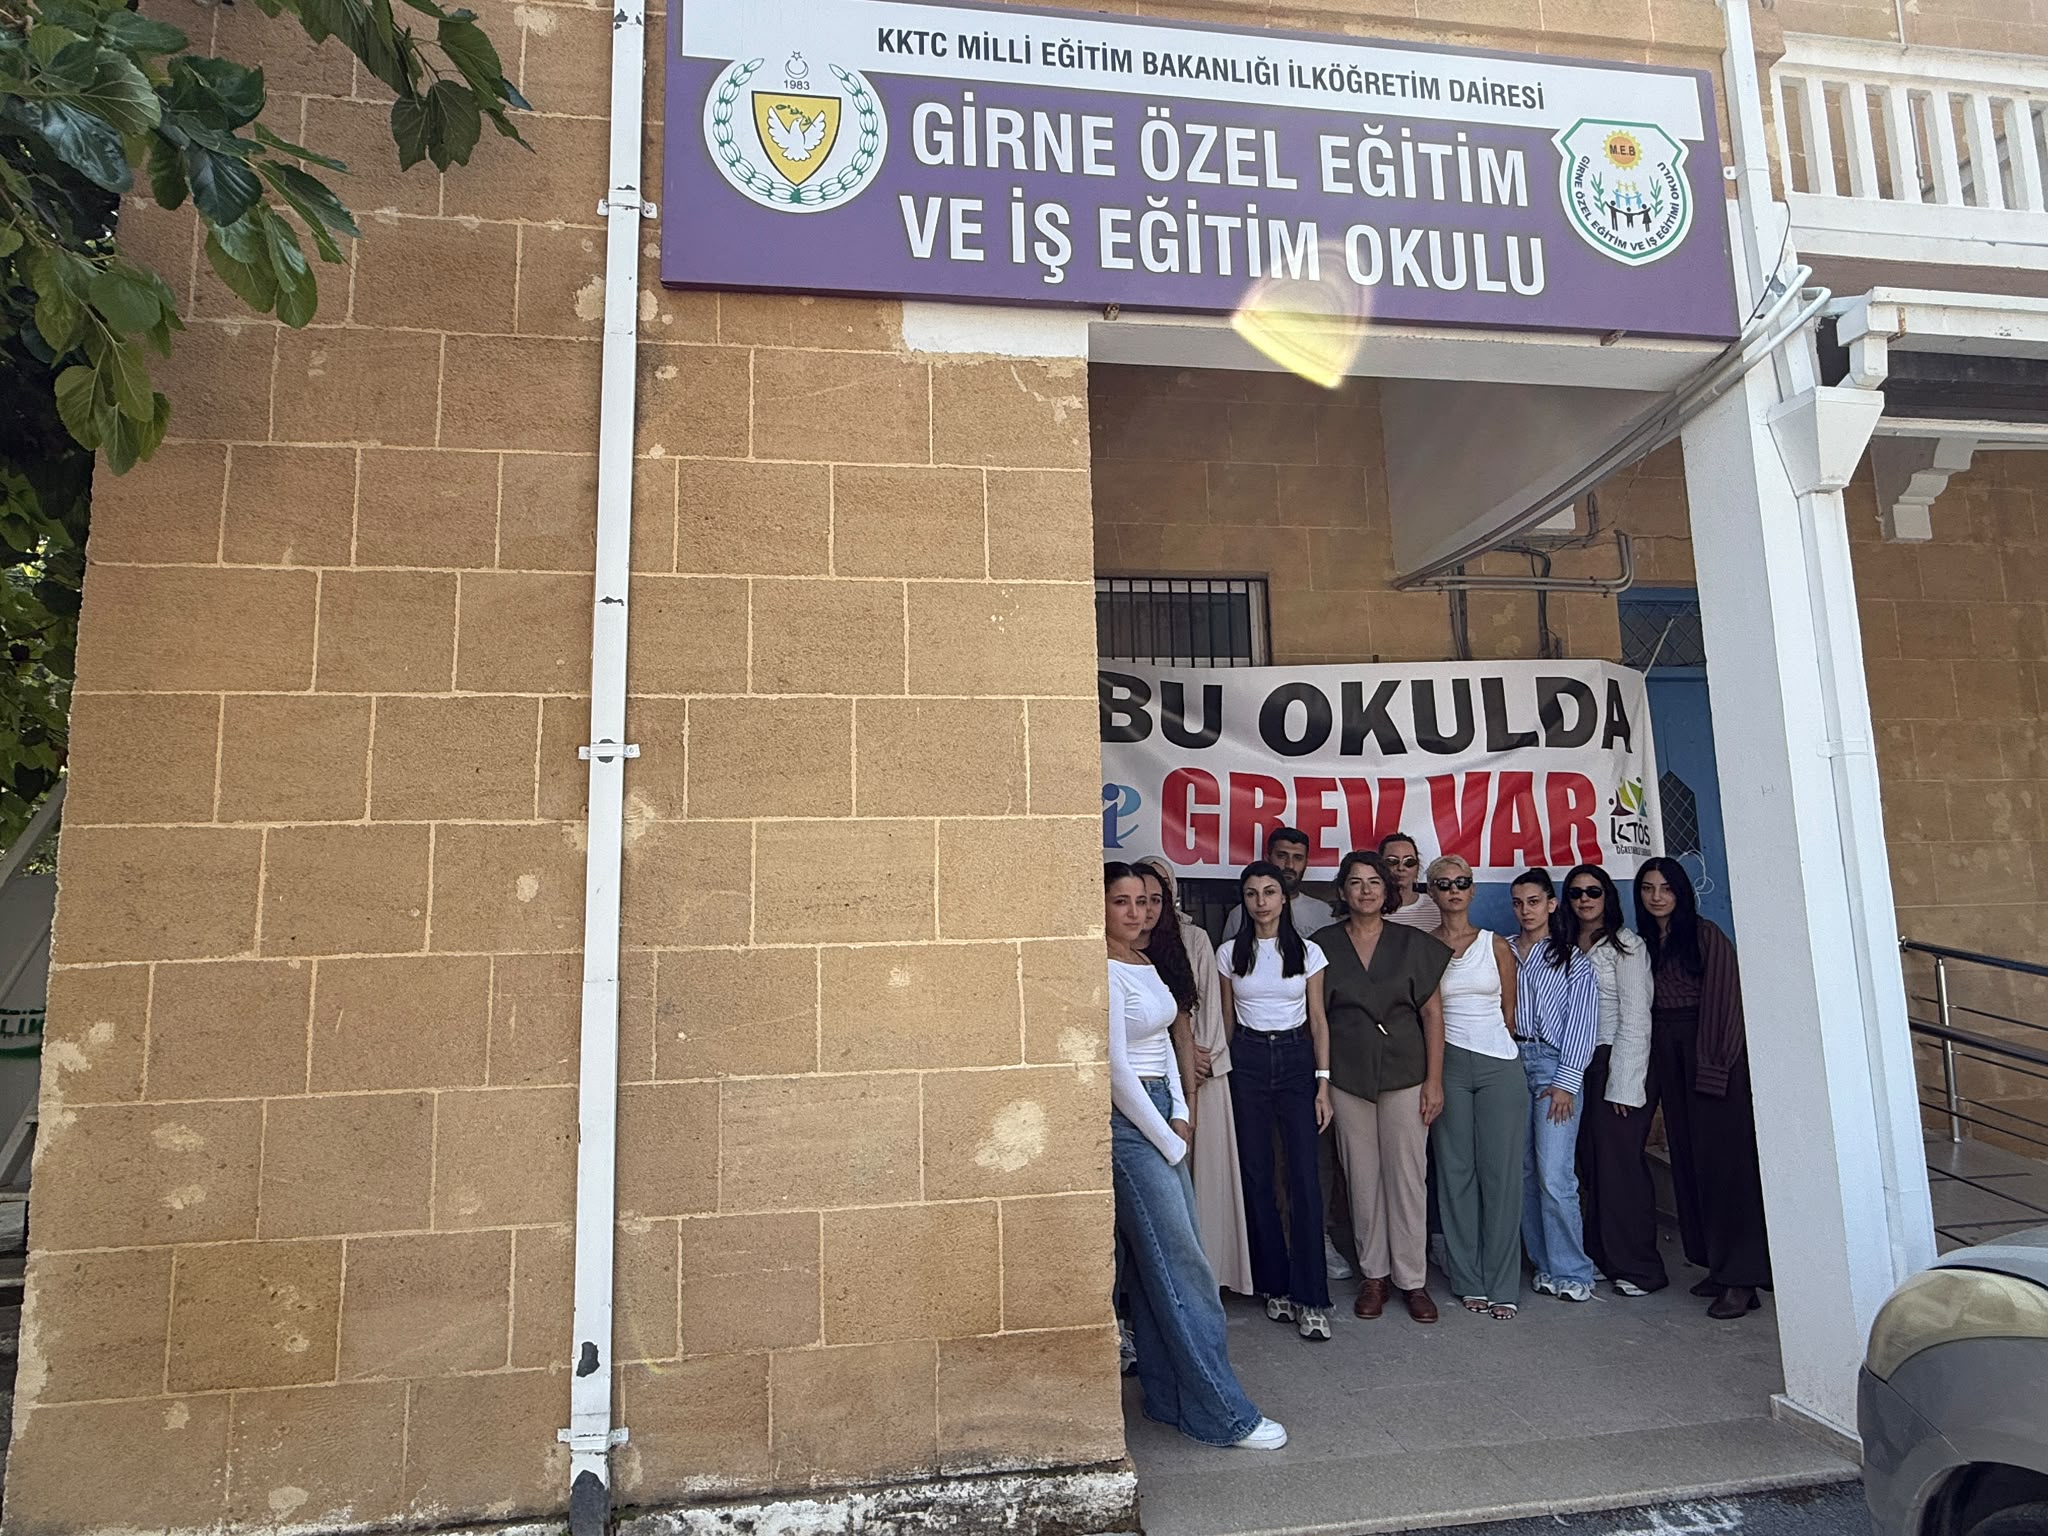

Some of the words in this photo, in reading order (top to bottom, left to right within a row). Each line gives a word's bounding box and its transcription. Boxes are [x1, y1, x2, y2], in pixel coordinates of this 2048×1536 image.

[783, 79, 811, 91] 1983
[877, 27, 947, 58] KKTC
[957, 30, 1032, 65] MİLLİ
[1041, 37, 1133, 74] EĞİTİM
[1142, 51, 1280, 87] BAKANLIĞI
[1288, 58, 1441, 101] İLKÖĞRETİM
[1448, 76, 1546, 110] DAİRESİ
[912, 91, 1116, 177] GİRNE
[1139, 106, 1298, 190] ÖZEL
[1319, 123, 1528, 207] EĞİTİM
[1574, 155, 1591, 188] GİRNE
[1656, 161, 1680, 200] OKULU
[1575, 191, 1593, 221] ÖZEL
[1655, 202, 1680, 240] EĞİTİMİ
[899, 195, 985, 262] VE
[1011, 187, 1073, 284] İŞ
[1099, 195, 1321, 282] EĞİTİM
[1344, 224, 1546, 296] OKULU
[1591, 220, 1628, 249] EĞİTİM
[1630, 241, 1645, 251] VE
[1645, 236, 1658, 247] İŞ
[1098, 670, 1223, 750] BU
[1258, 676, 1633, 756] OKULDA
[1161, 767, 1406, 867] GREV
[1425, 770, 1604, 868] VAR
[1610, 816, 1651, 847] KTÖS
